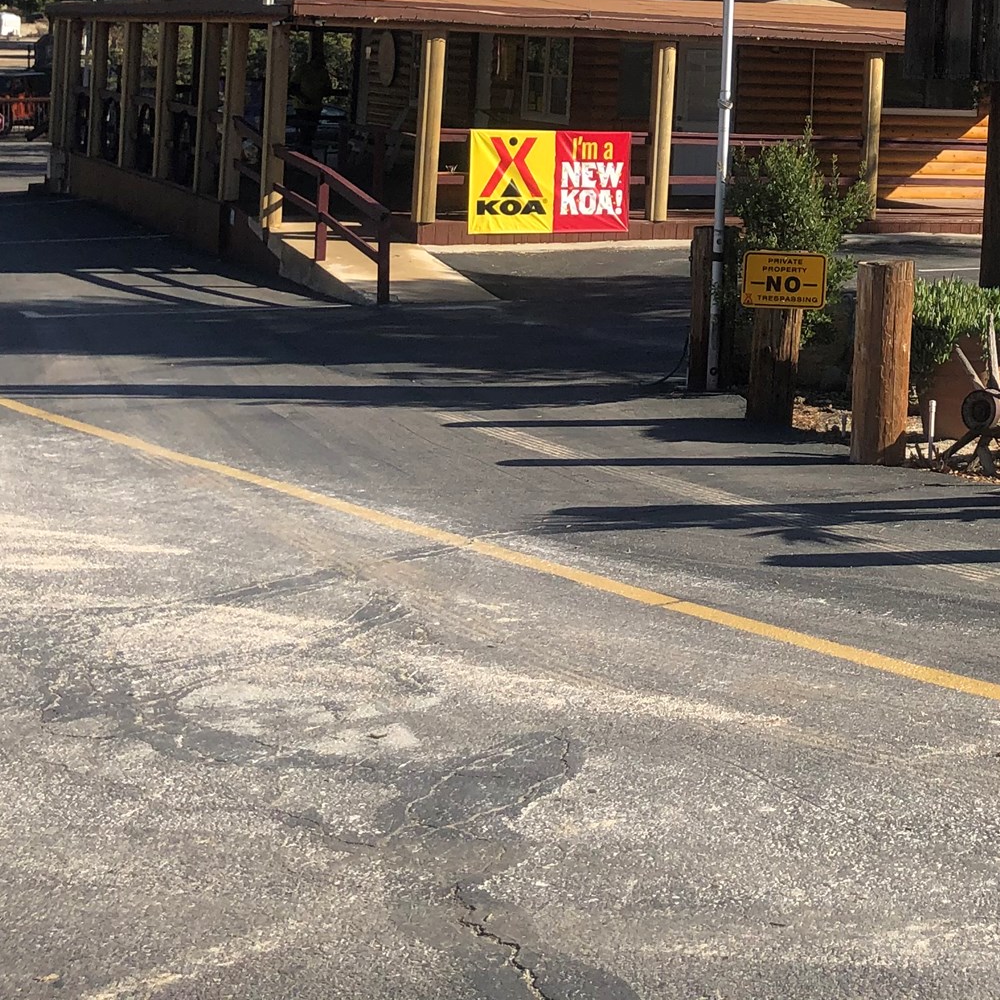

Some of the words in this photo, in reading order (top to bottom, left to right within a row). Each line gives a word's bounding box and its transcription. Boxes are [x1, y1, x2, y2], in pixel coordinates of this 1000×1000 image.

[572, 136, 598, 160] I'm
[603, 141, 614, 160] a
[560, 161, 625, 188] NEW
[476, 199, 547, 216] KOA
[559, 189, 623, 216] KOA!
[765, 275, 801, 293] NO
[757, 294, 818, 303] TRESPASSING
